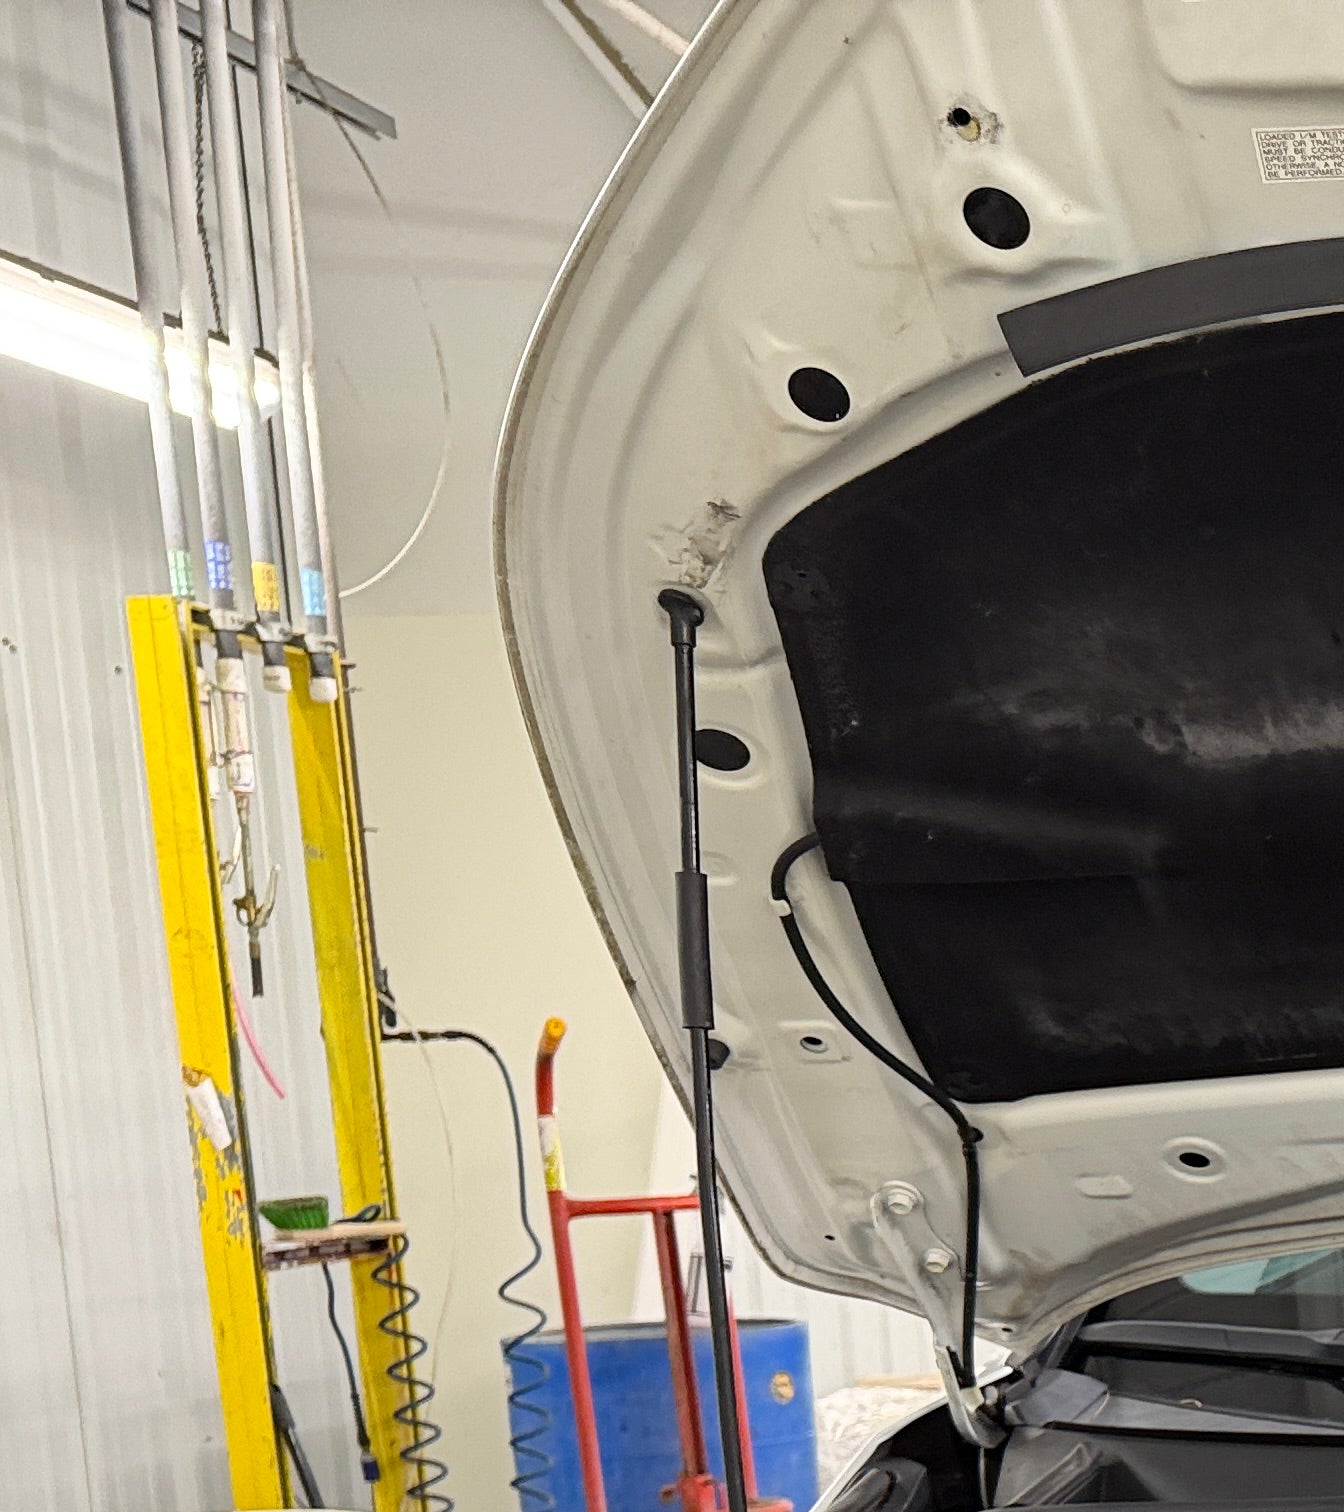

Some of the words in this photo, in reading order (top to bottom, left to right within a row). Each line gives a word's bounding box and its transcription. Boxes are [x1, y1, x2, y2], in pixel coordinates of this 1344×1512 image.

[1259, 132, 1296, 142] LOADED
[1261, 140, 1288, 149] DRIVE
[1292, 139, 1307, 147] OR
[1263, 147, 1288, 156] MUST
[1293, 147, 1306, 155] BE
[1264, 155, 1296, 164] SPEED
[1267, 170, 1280, 179] BE
